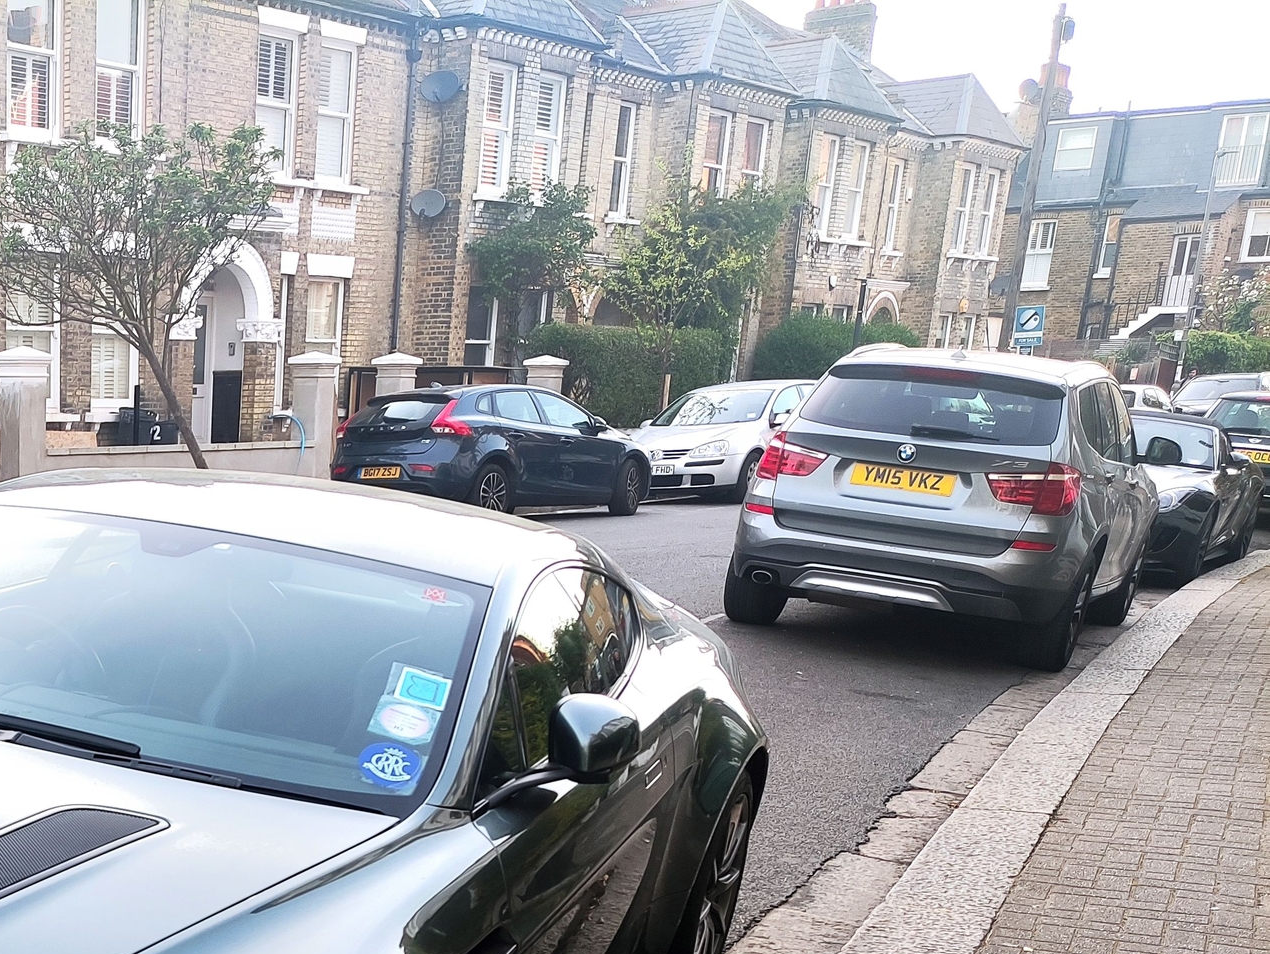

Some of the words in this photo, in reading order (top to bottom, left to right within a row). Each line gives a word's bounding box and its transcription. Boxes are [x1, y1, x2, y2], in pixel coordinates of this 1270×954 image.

[363, 468, 380, 477] BG17
[381, 467, 398, 476] ZSJ
[655, 466, 671, 474] FHD
[864, 466, 904, 486] YM15
[907, 471, 945, 491] VKZ
